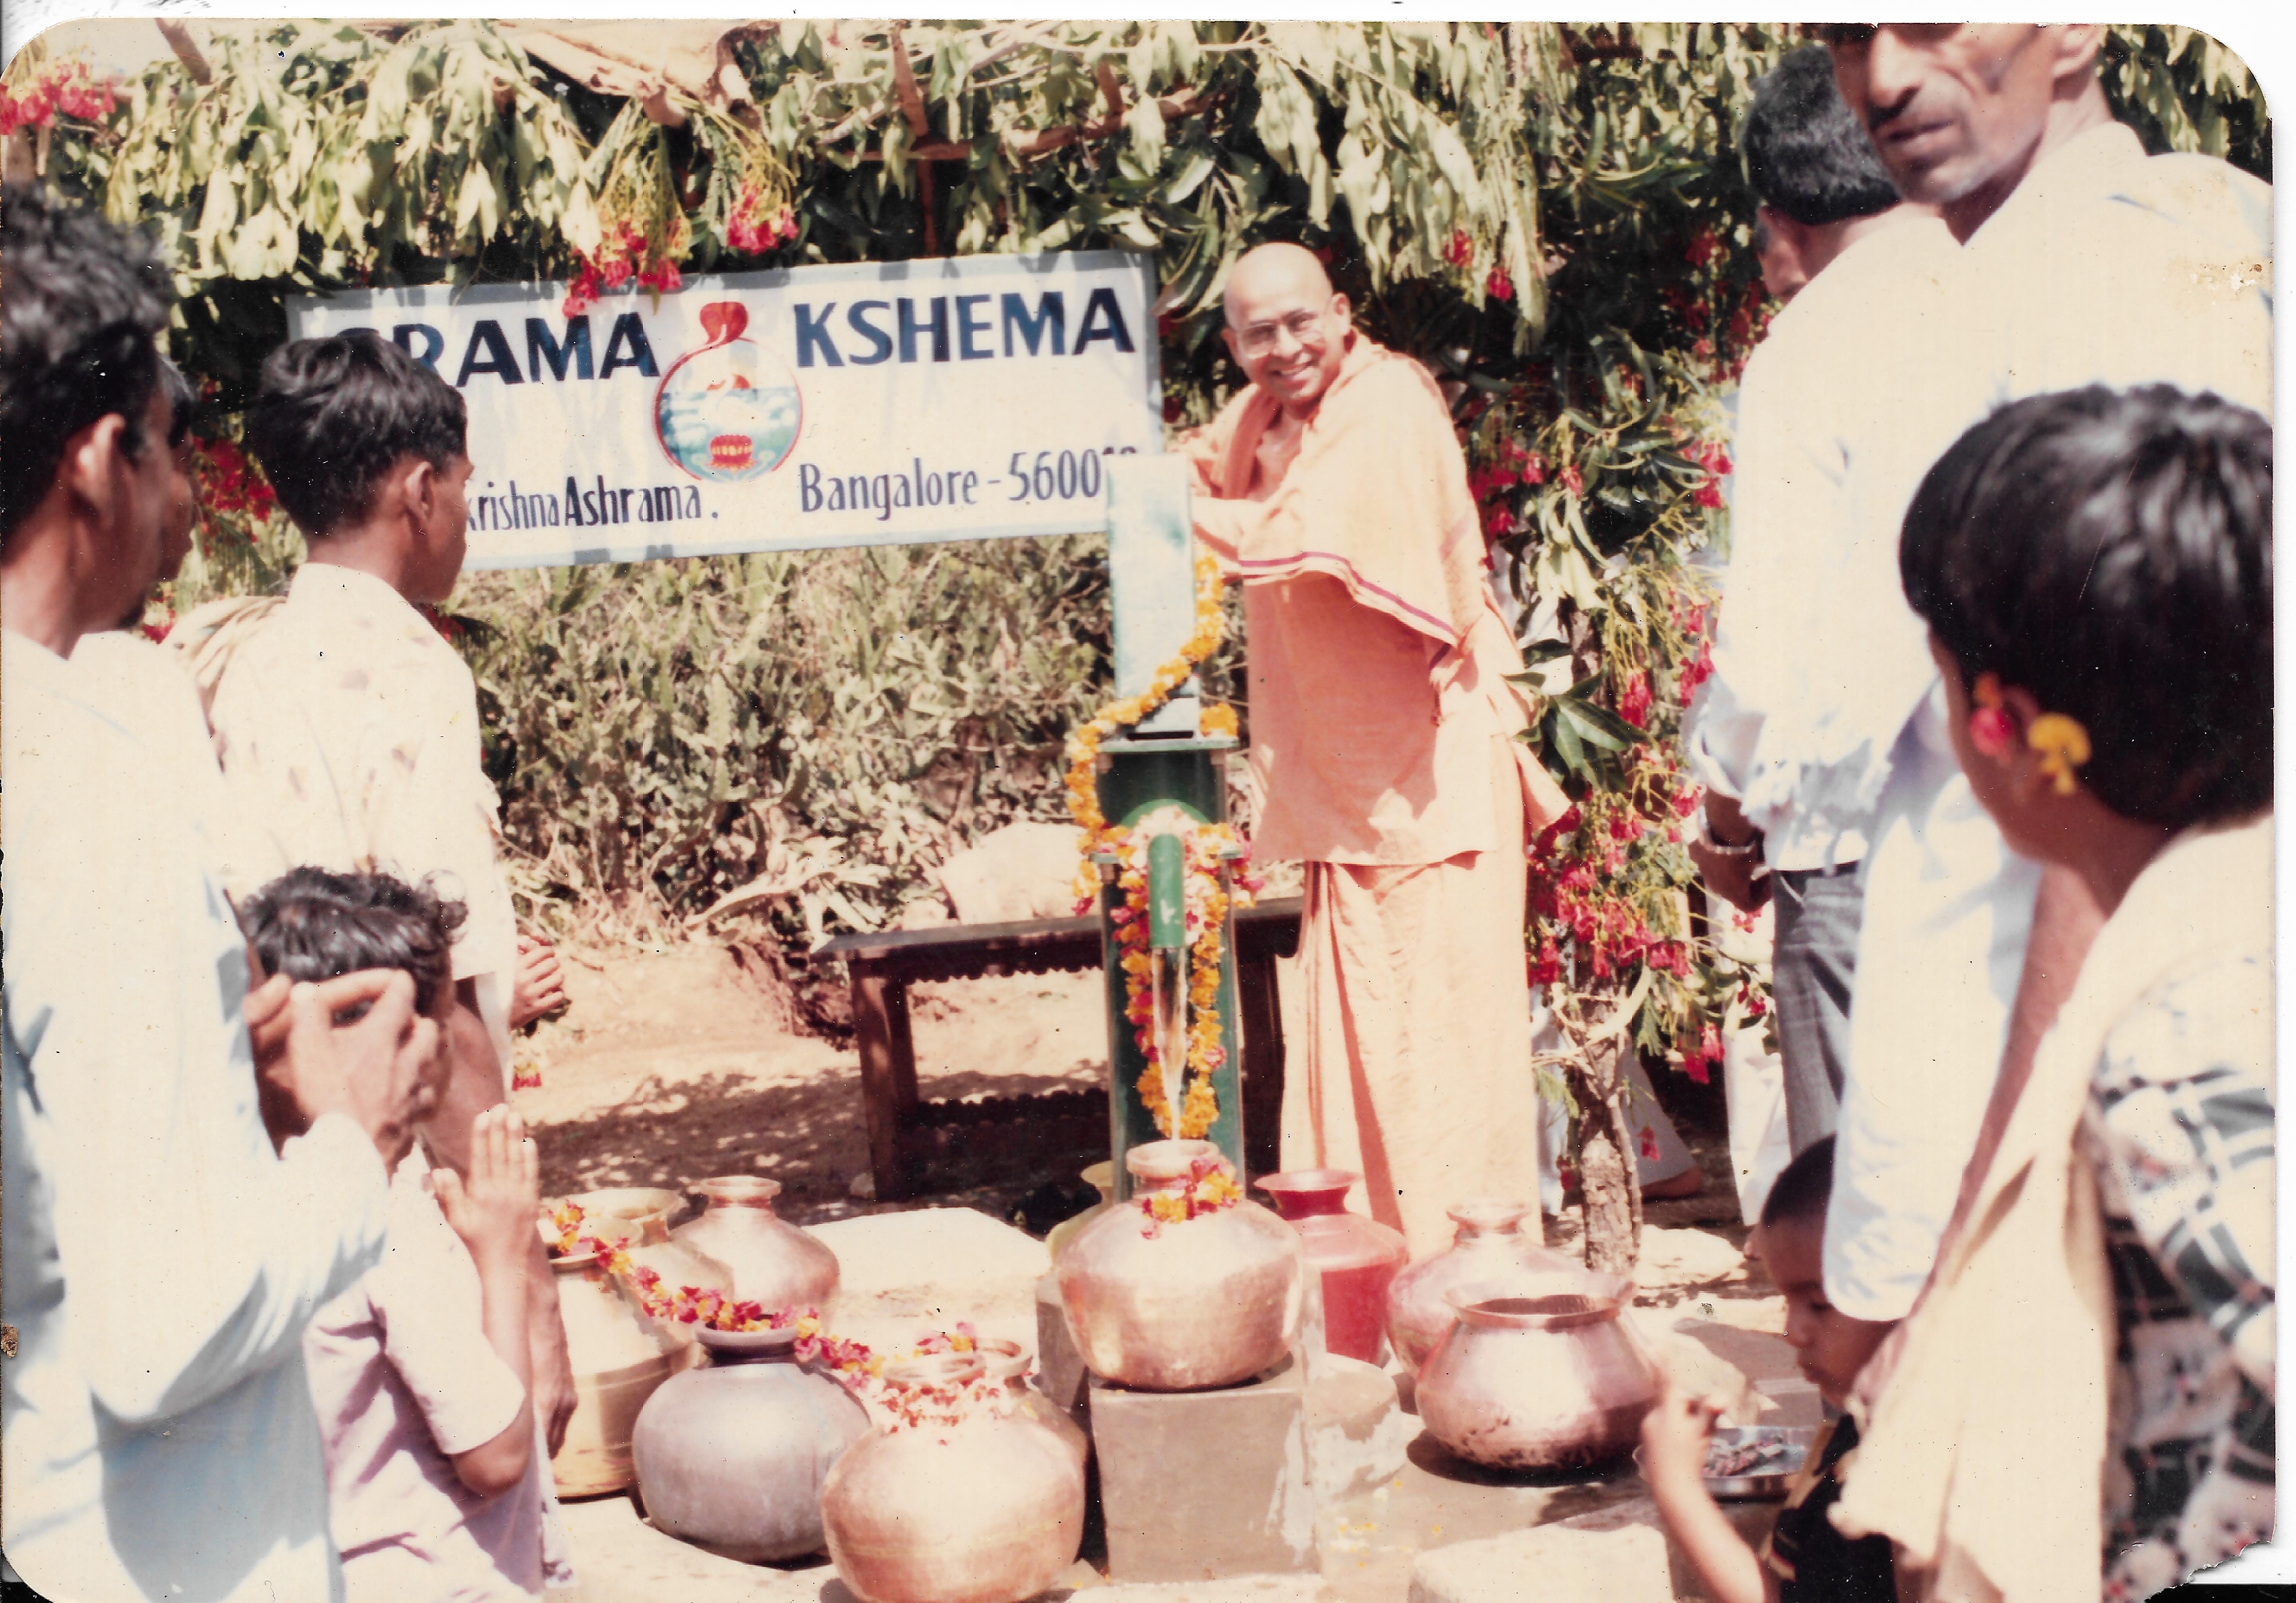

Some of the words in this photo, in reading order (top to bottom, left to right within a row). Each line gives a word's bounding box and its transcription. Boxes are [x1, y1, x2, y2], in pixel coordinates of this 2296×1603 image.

[334, 311, 661, 387] RAMA
[793, 287, 1136, 368] KSHEMA
[1008, 446, 1137, 501] 5600
